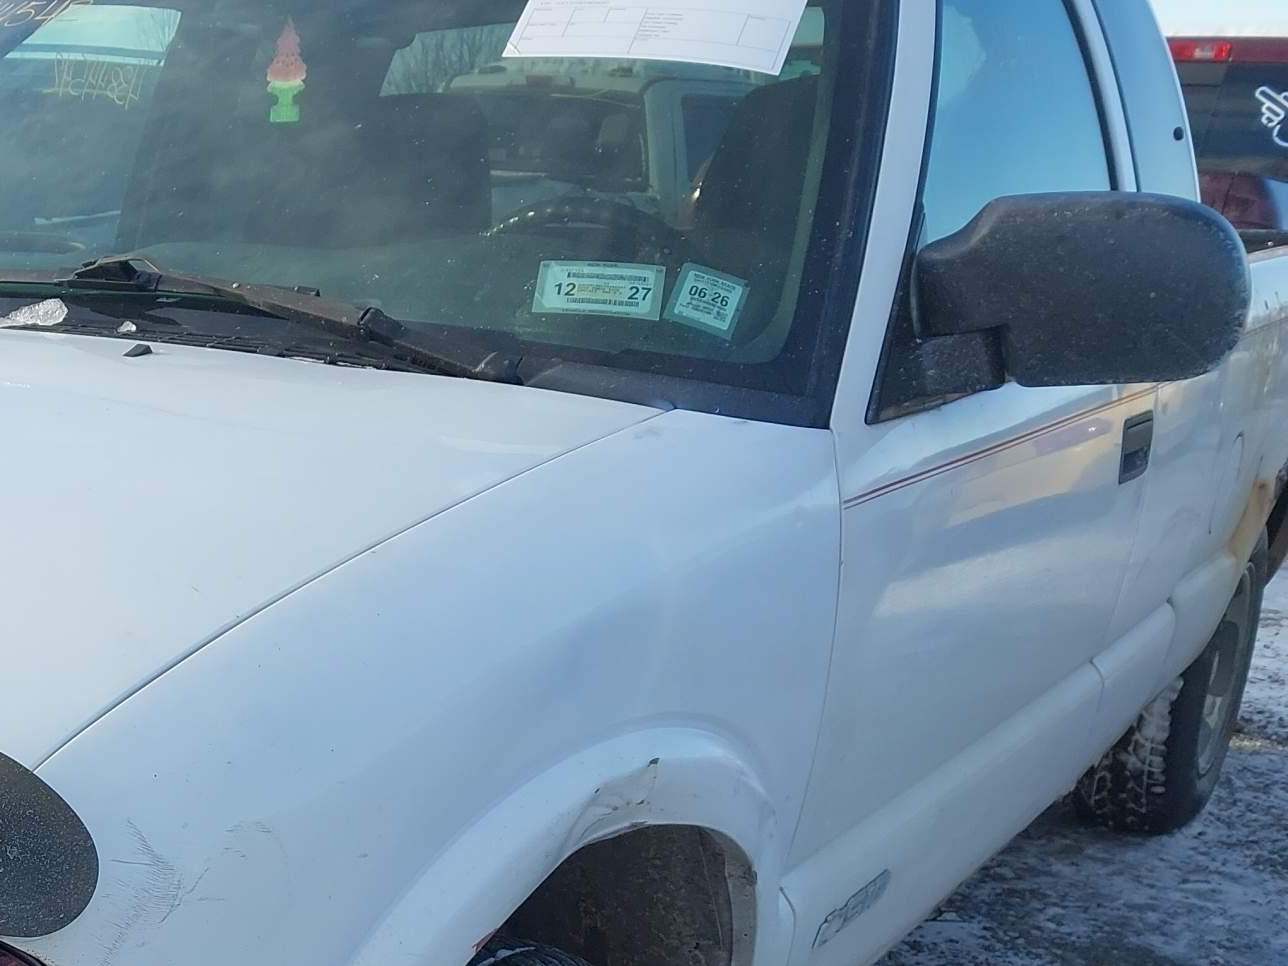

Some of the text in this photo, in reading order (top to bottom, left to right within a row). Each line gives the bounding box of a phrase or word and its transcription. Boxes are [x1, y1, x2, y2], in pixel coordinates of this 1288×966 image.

[554, 282, 576, 296] 12
[627, 286, 652, 301] 27
[688, 285, 708, 298] 06
[711, 291, 730, 307] 26
